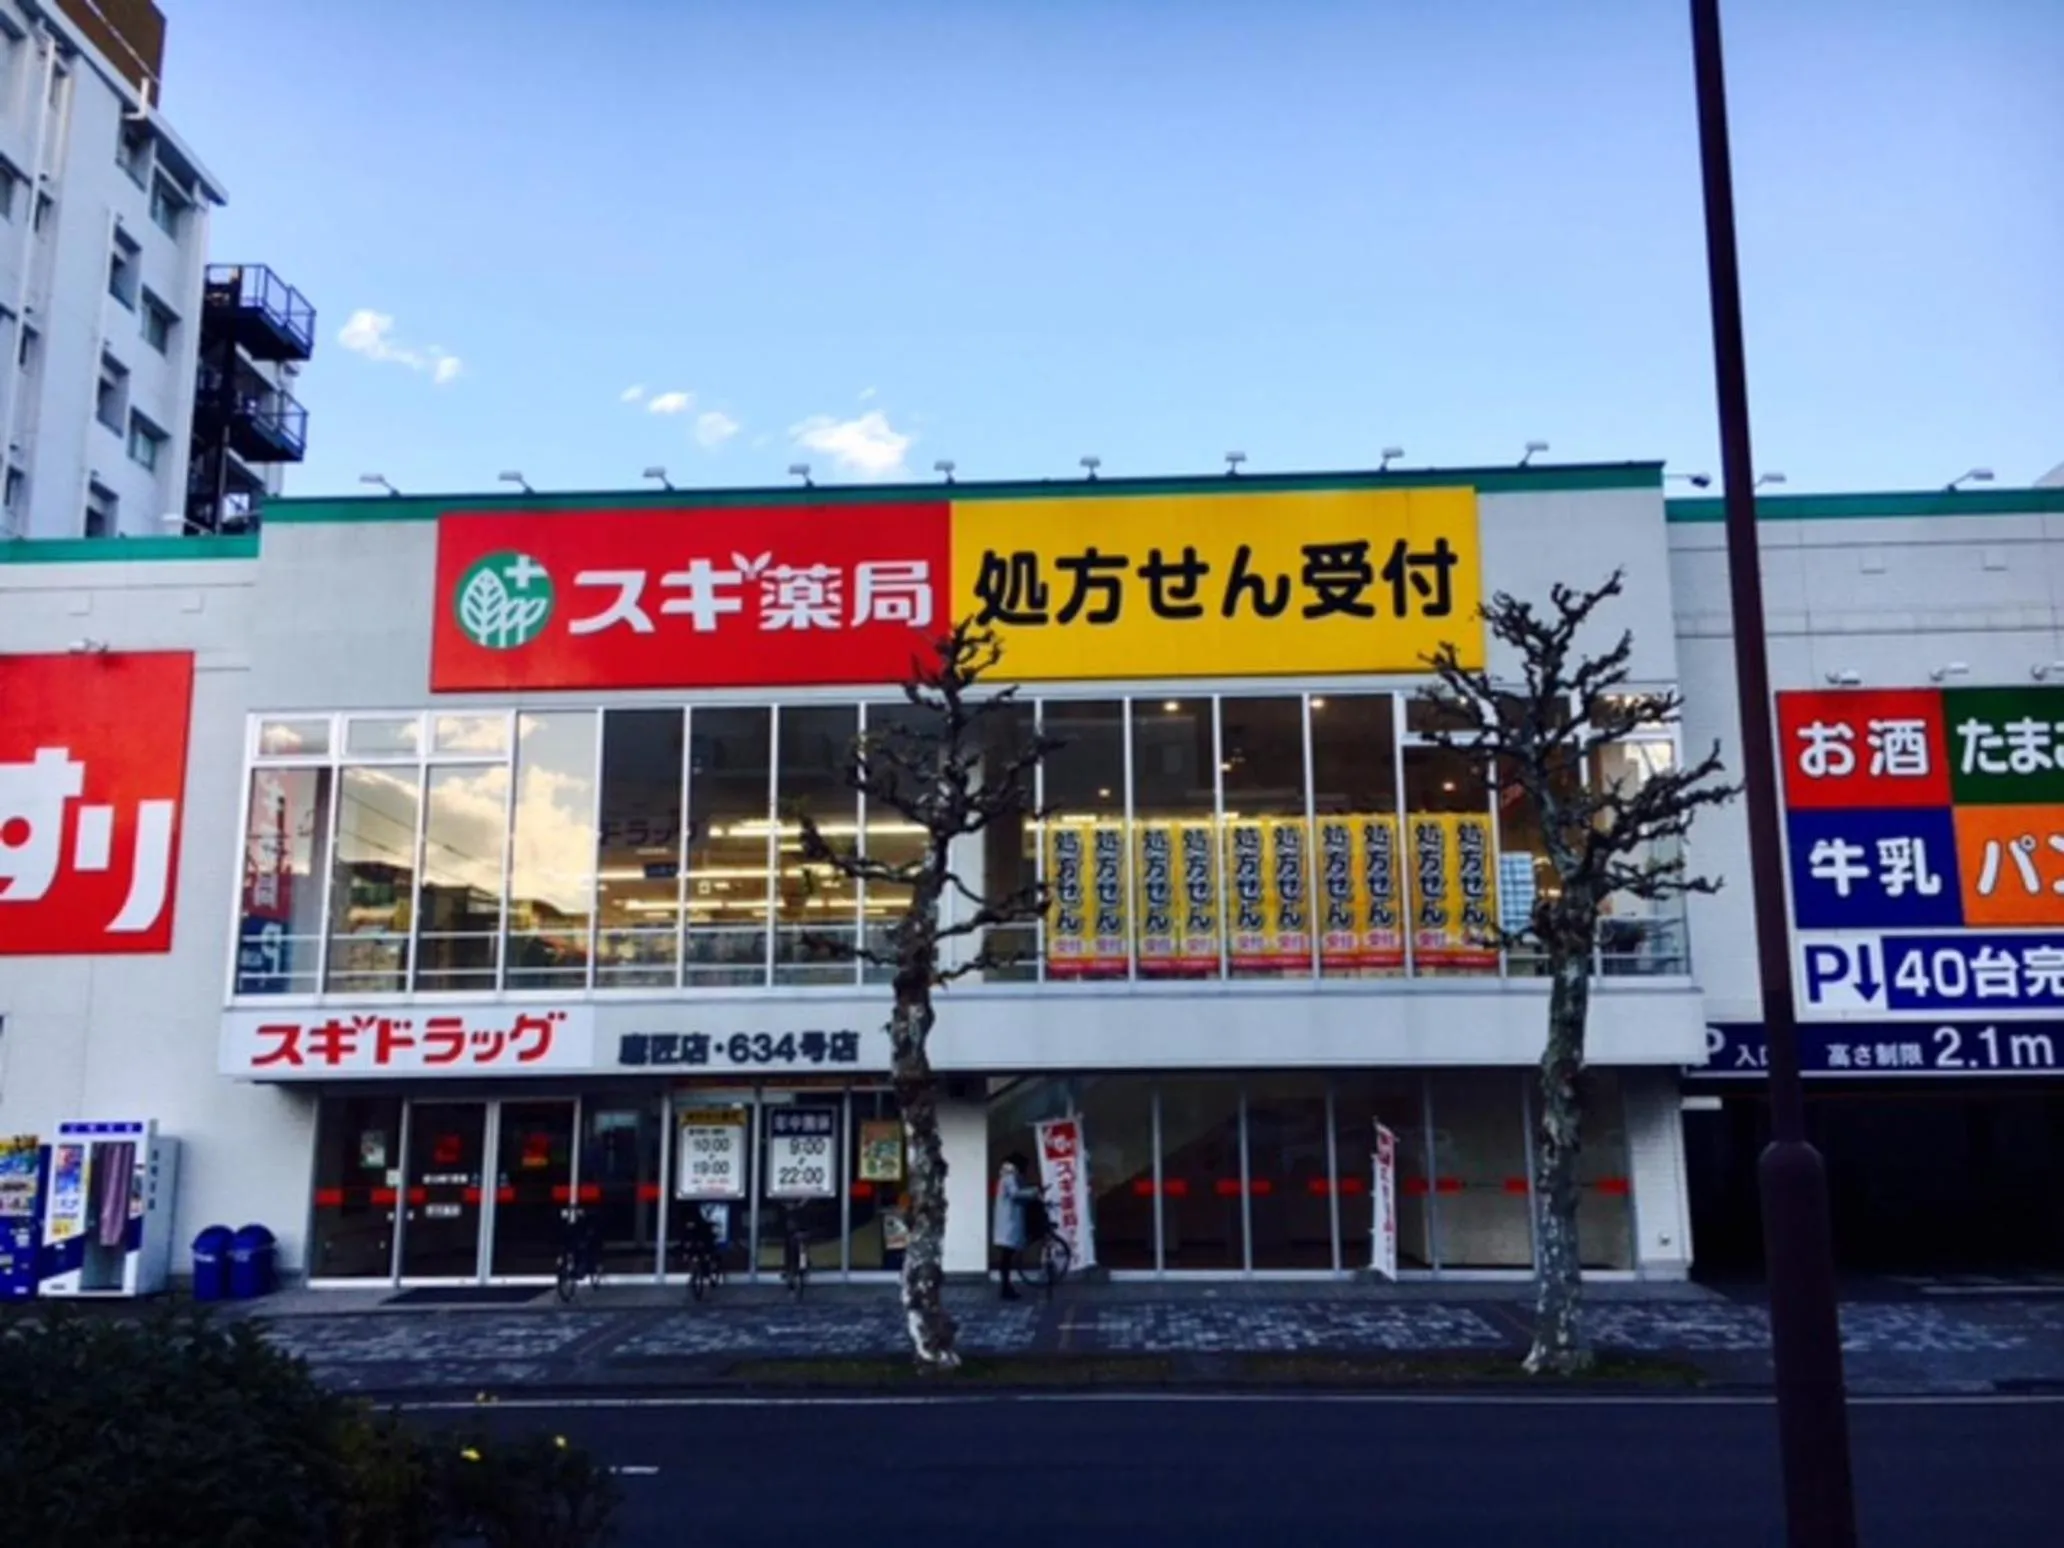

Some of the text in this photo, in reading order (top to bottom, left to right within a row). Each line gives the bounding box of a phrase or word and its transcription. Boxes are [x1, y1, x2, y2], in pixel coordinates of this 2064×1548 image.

[568, 552, 933, 634] スギ薬局
[973, 537, 1458, 627] 処方せん受付
[1797, 719, 1929, 777] お酒
[1957, 717, 2064, 773] たま
[1809, 837, 1942, 897] 牛乳
[251, 1010, 566, 1065] スギドラッグ
[1735, 1044, 1768, 1068] 入
[1933, 1026, 2055, 1068] 2.1m
[778, 1165, 826, 1185] 22:00
